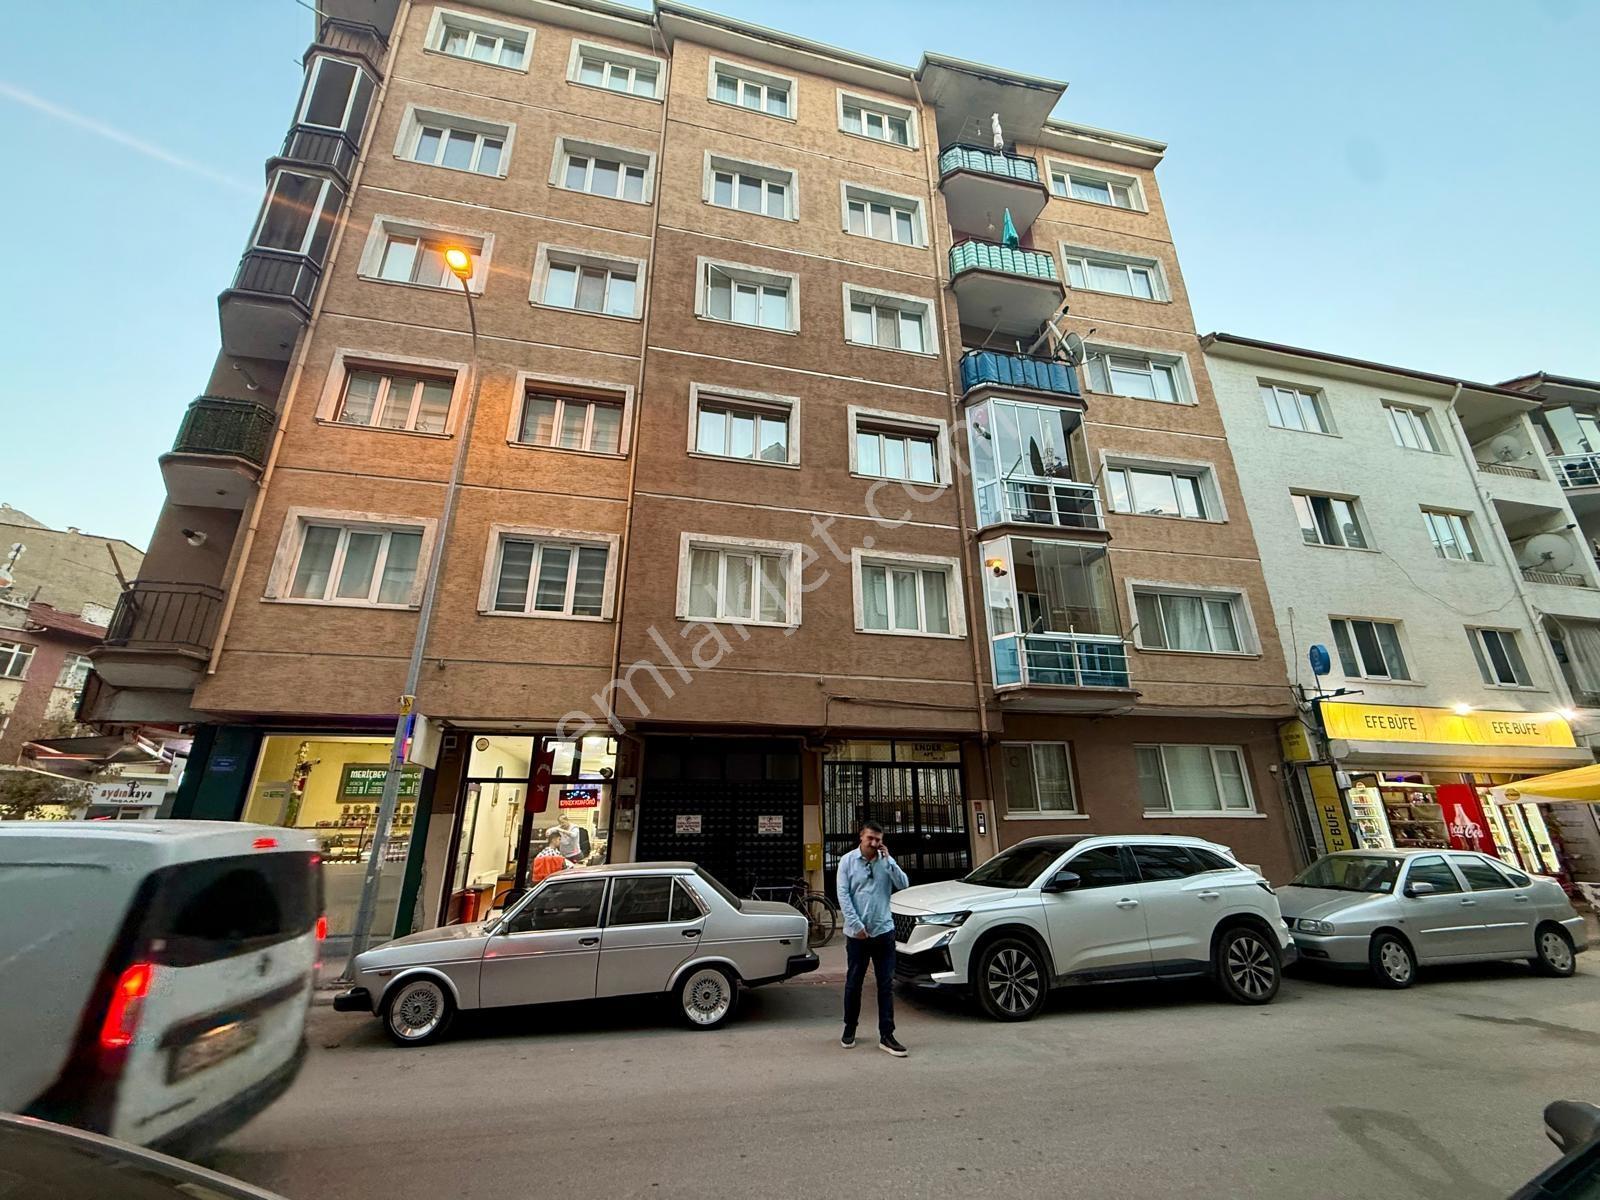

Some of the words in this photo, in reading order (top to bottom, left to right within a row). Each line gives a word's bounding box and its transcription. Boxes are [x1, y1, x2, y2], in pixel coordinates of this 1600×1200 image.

[1364, 715, 1387, 729] EFE
[1387, 714, 1417, 730] BÜFE
[1491, 721, 1513, 734] EFE
